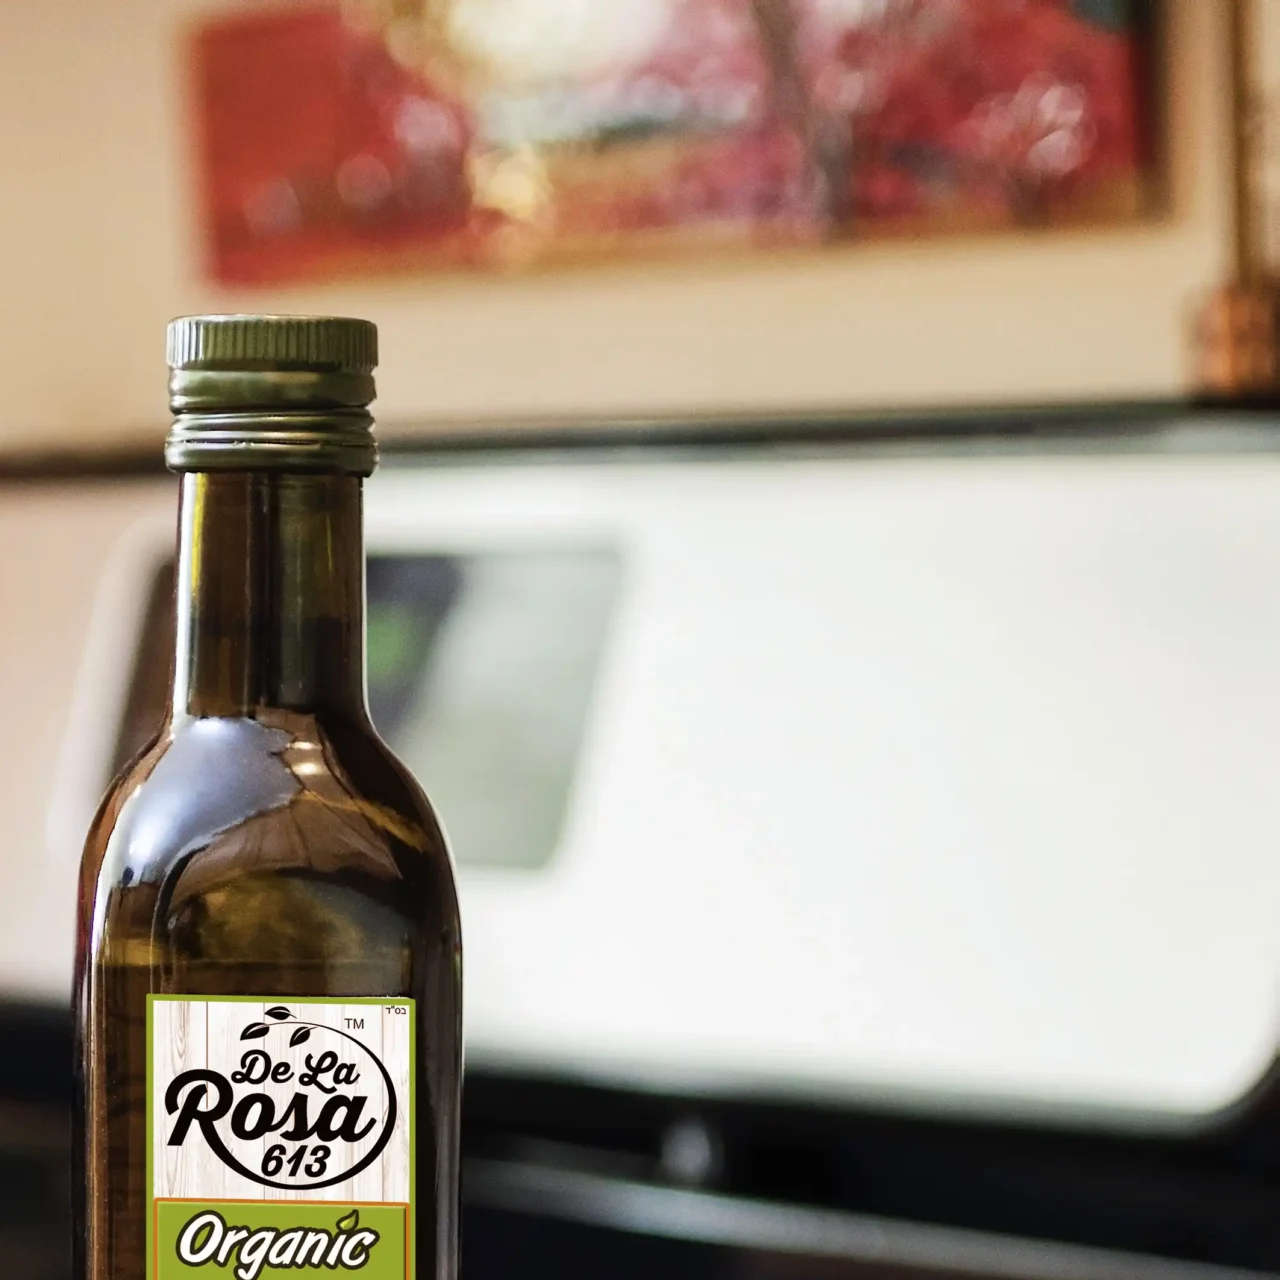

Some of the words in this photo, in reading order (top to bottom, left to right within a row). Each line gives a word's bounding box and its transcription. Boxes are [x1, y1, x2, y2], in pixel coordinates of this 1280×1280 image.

[344, 1018, 364, 1030] TM
[231, 1049, 294, 1084] De
[298, 1051, 360, 1094] La
[165, 1069, 377, 1146] Rosa
[261, 1144, 331, 1177] 613
